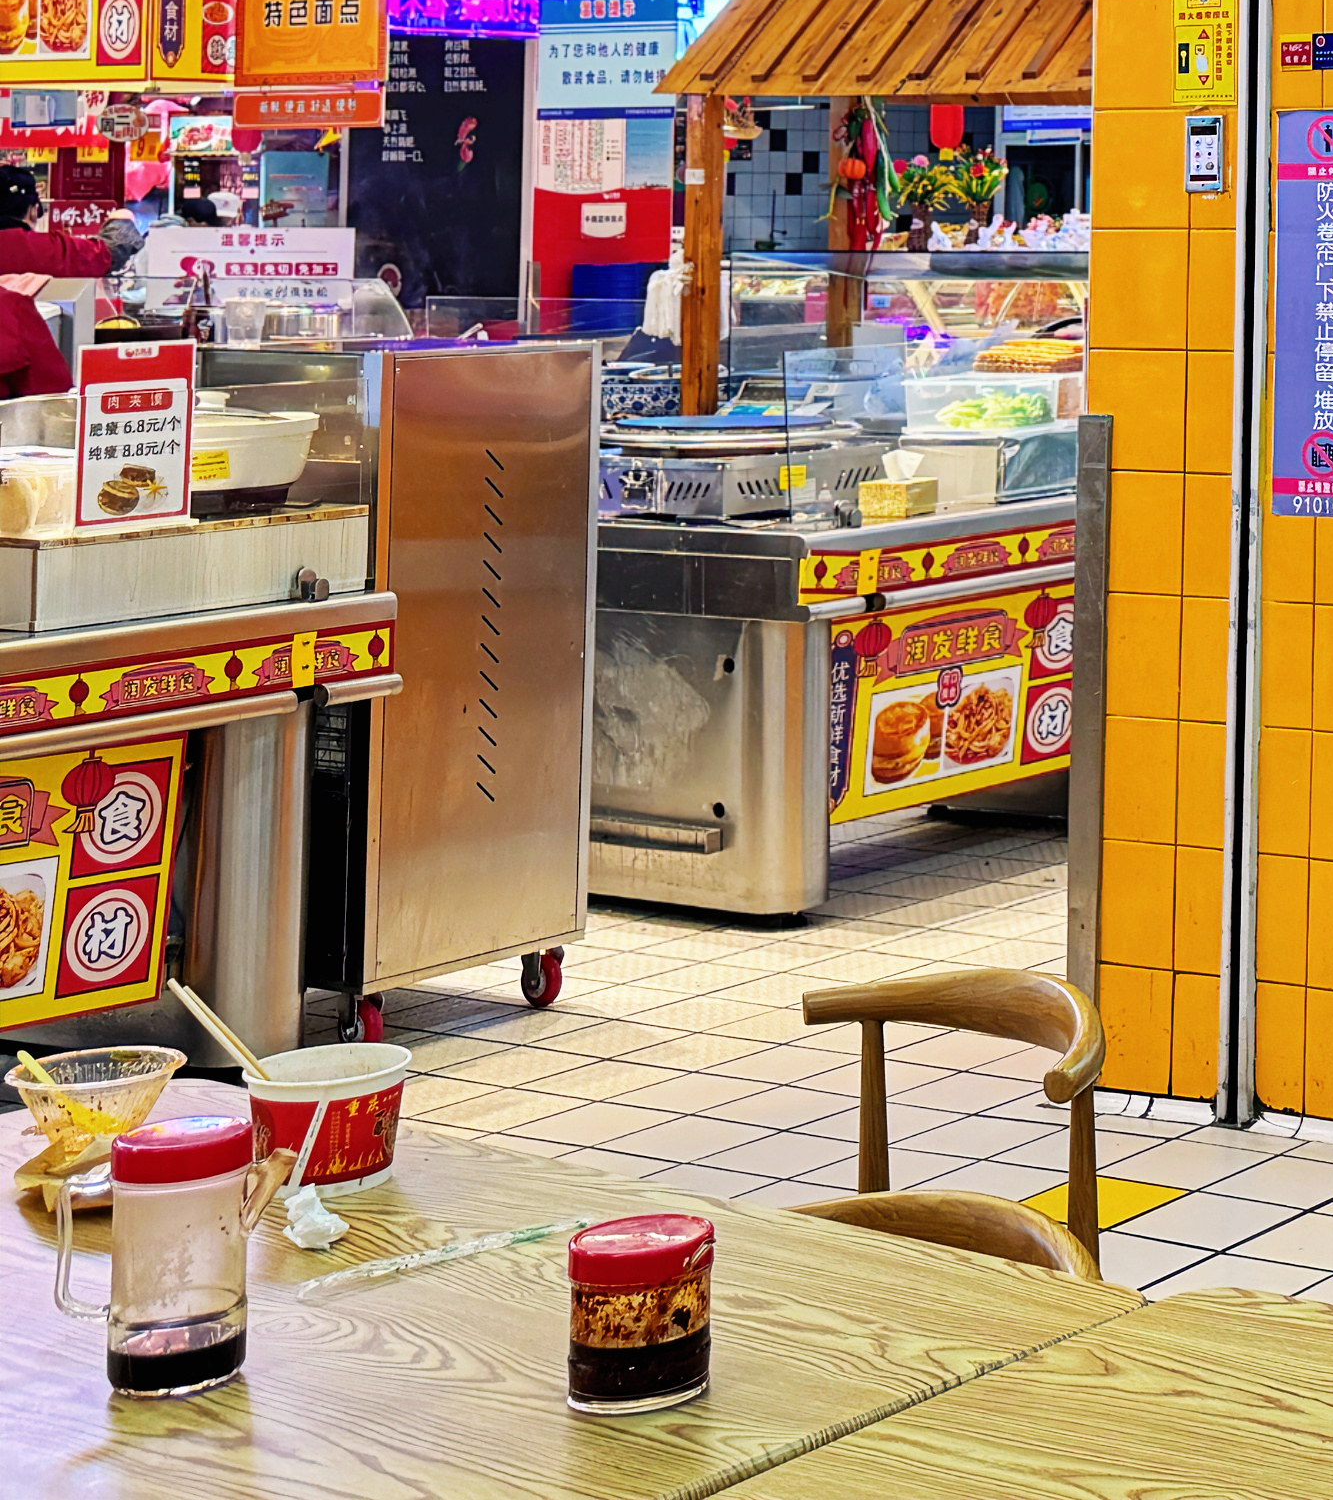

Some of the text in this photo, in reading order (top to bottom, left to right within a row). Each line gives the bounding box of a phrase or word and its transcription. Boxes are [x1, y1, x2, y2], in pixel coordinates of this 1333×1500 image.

[549, 41, 660, 58] 为了您和他人的健康
[221, 233, 285, 247] 温馨提示
[89, 415, 181, 437] 肥瘦 6.8元/个
[88, 439, 181, 461] 纯瘦 8.8元/个
[905, 622, 1002, 666] 润发鲜食
[124, 671, 197, 700] 润发鲜食
